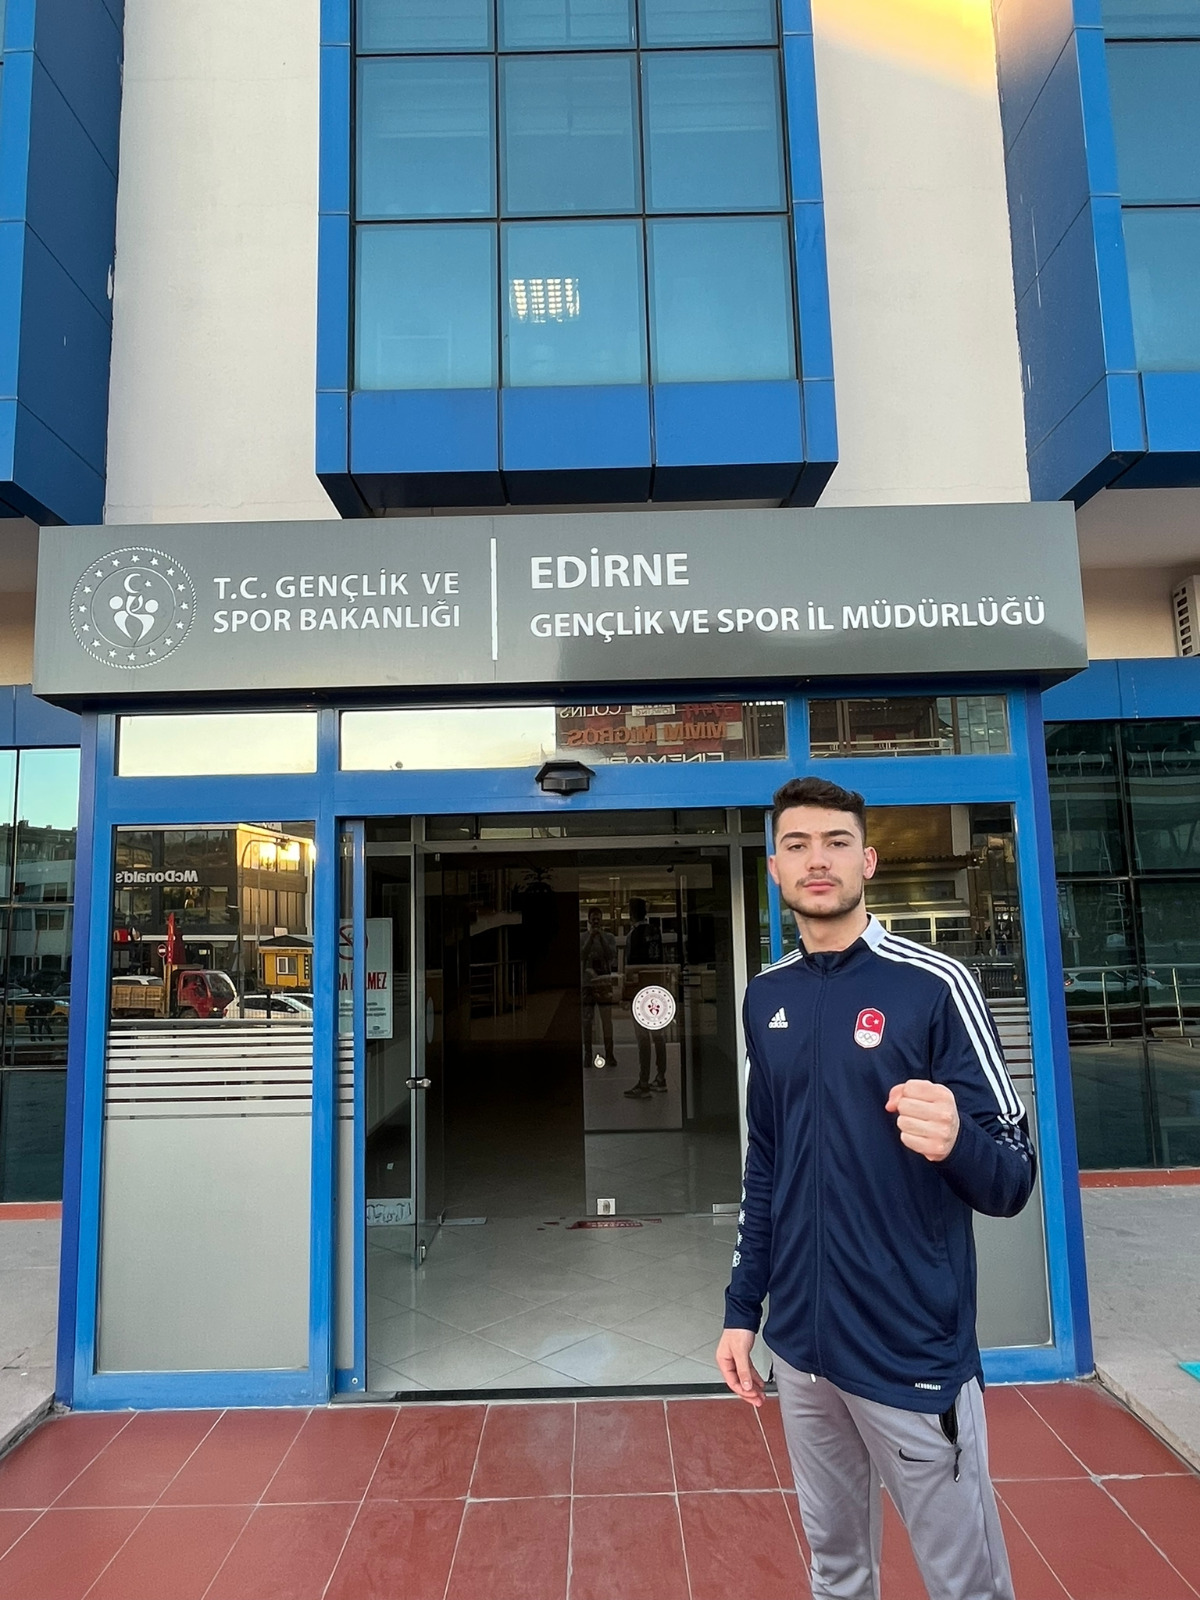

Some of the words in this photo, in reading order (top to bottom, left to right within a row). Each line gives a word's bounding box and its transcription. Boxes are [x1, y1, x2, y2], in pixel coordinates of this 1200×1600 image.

[213, 576, 268, 600] T.C.
[275, 569, 409, 604] GENÇLİK
[421, 572, 460, 595] VE
[530, 547, 690, 589] EDİRNE
[213, 608, 292, 634] SPOR
[299, 594, 460, 631] BAKANLIĞI
[530, 605, 665, 643] GENÇLİK
[668, 609, 710, 634] VE
[717, 607, 800, 633] SPOR
[807, 601, 835, 631] İL
[842, 595, 1045, 630] MÜDÜRLÜĞÜ
